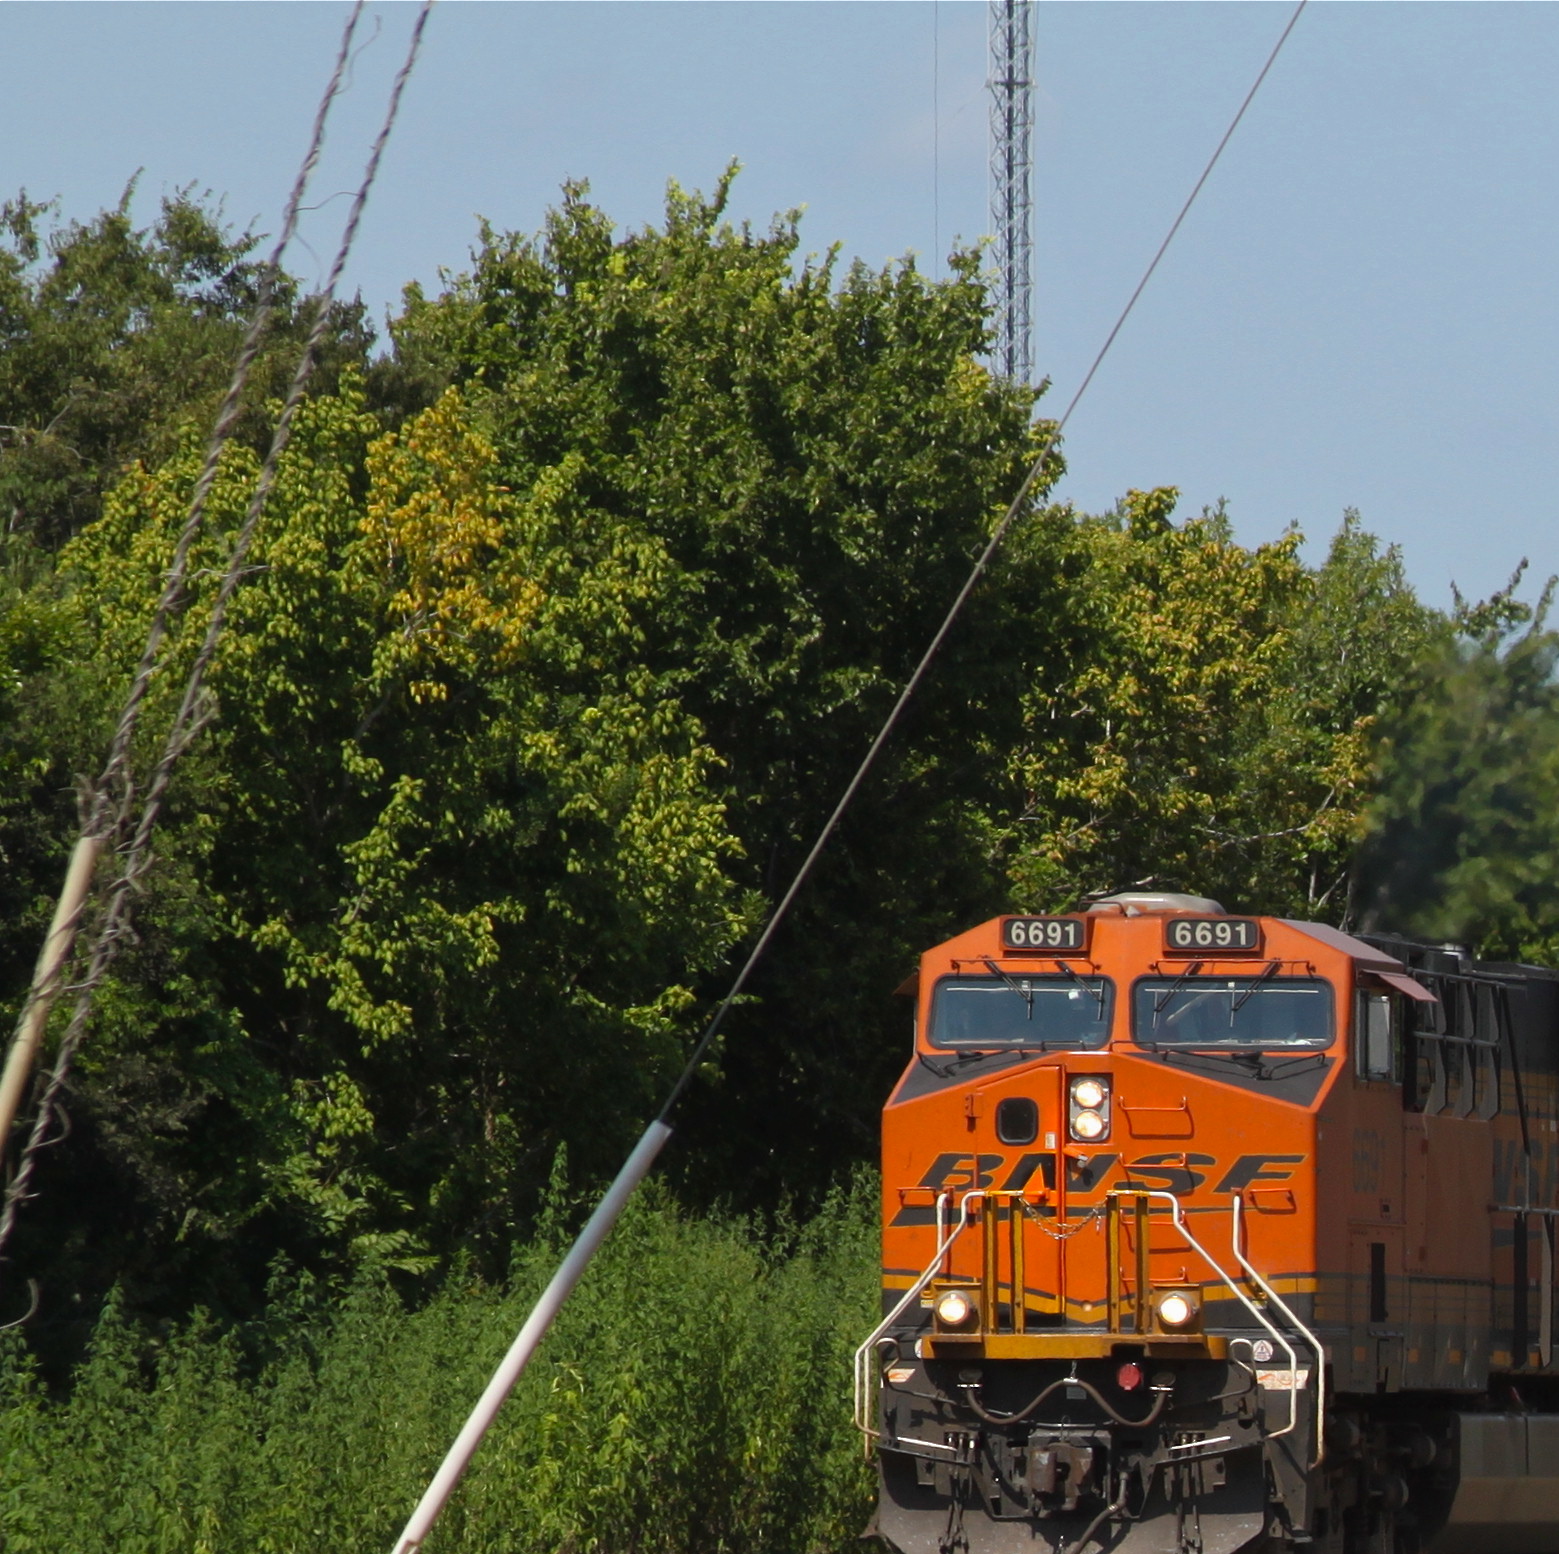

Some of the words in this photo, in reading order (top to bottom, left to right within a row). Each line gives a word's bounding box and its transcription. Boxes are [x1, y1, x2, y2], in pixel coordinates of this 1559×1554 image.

[1010, 921, 1077, 946] 6691
[1174, 921, 1248, 947] 6691
[915, 1152, 1310, 1194] BNSF
